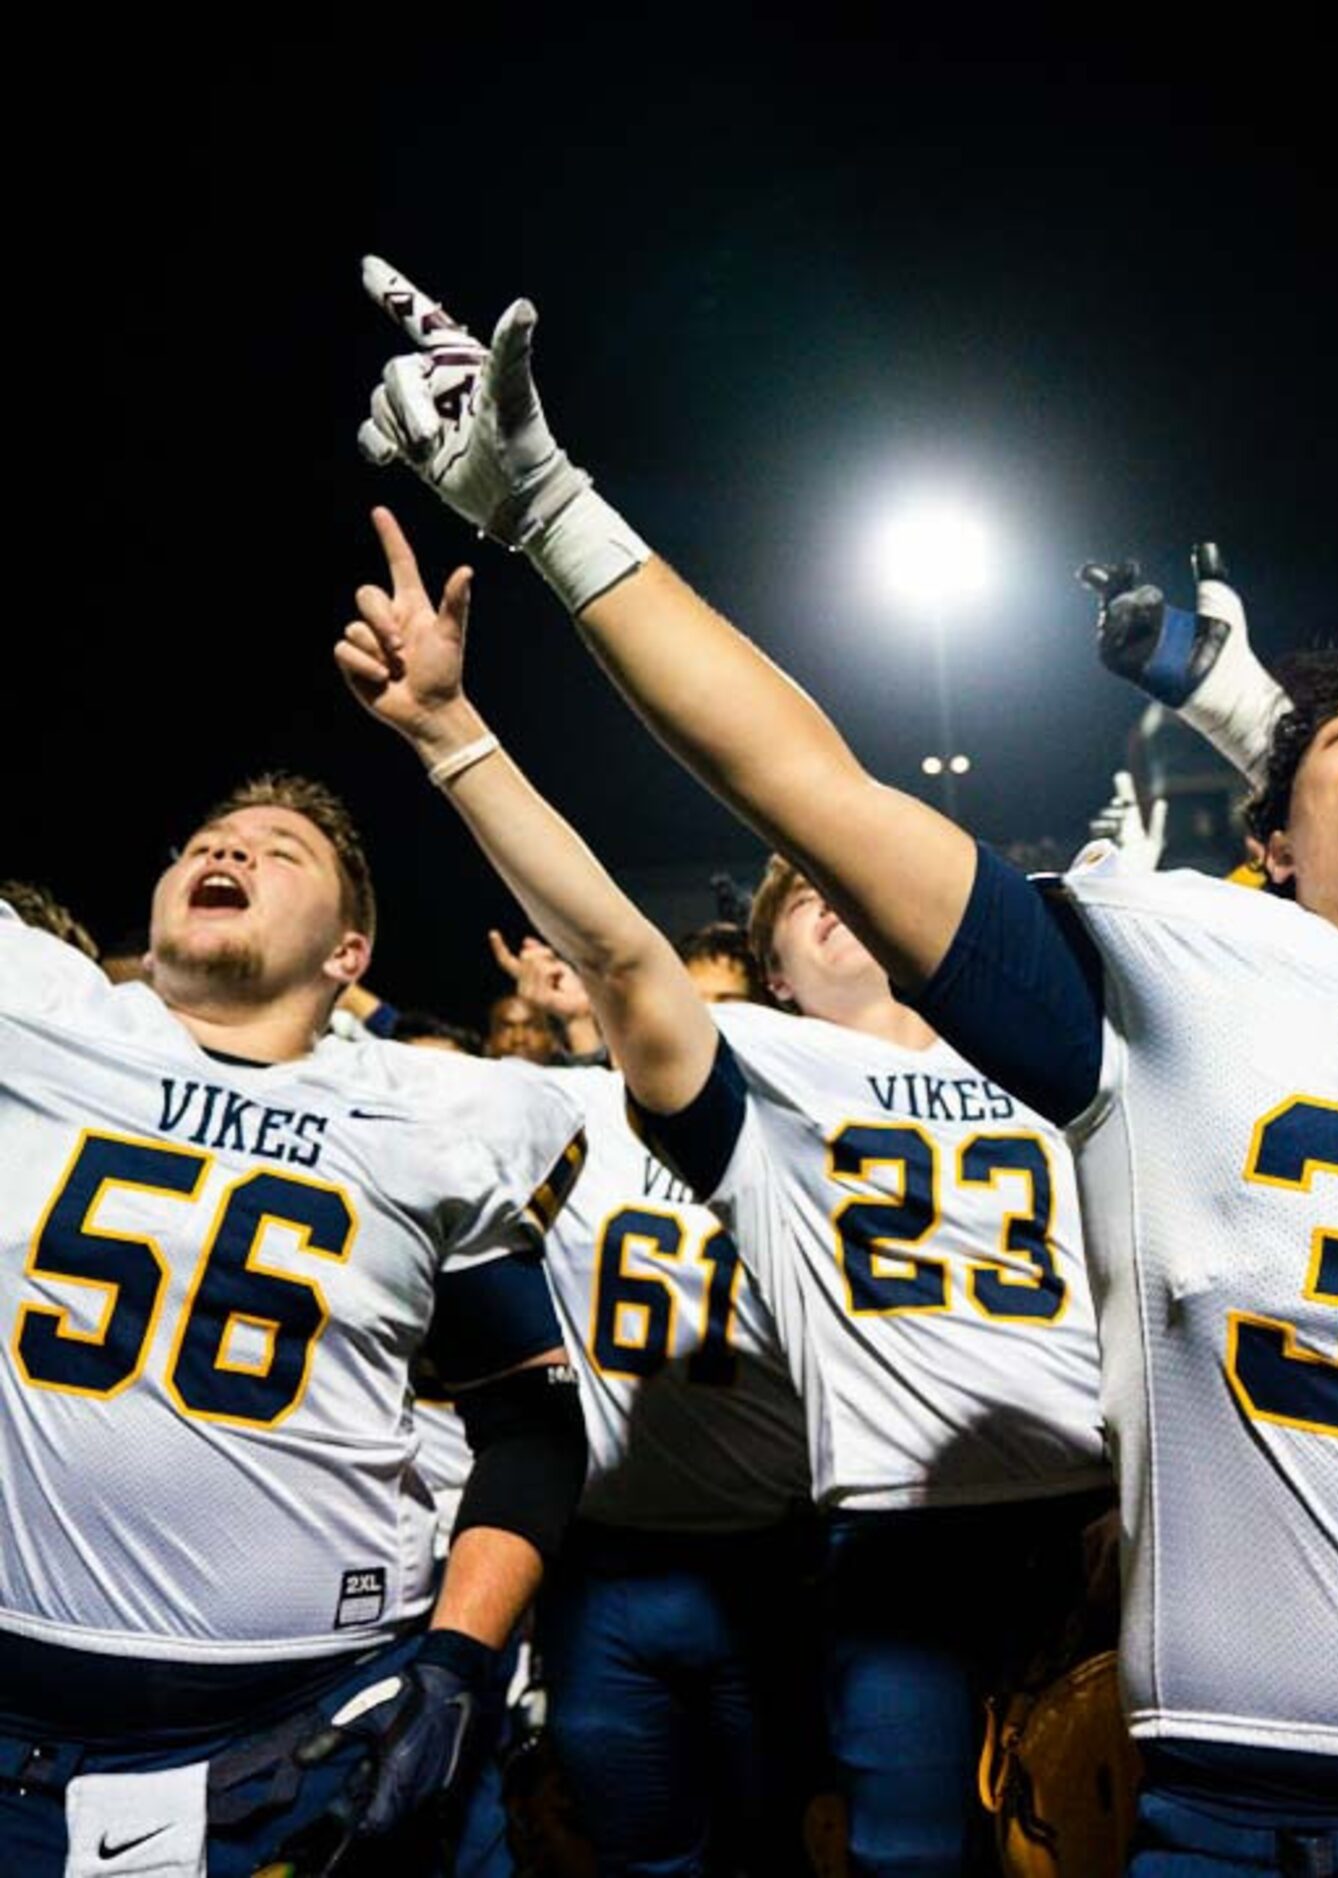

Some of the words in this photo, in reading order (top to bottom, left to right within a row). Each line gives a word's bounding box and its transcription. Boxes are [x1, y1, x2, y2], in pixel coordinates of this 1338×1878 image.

[158, 1078, 327, 1166] VIKES
[867, 1074, 1014, 1121] VIKES
[12, 1127, 358, 1428] 56
[826, 1120, 1072, 1324] 23
[590, 1205, 745, 1385] 61
[347, 1574, 381, 1594] 2XL
